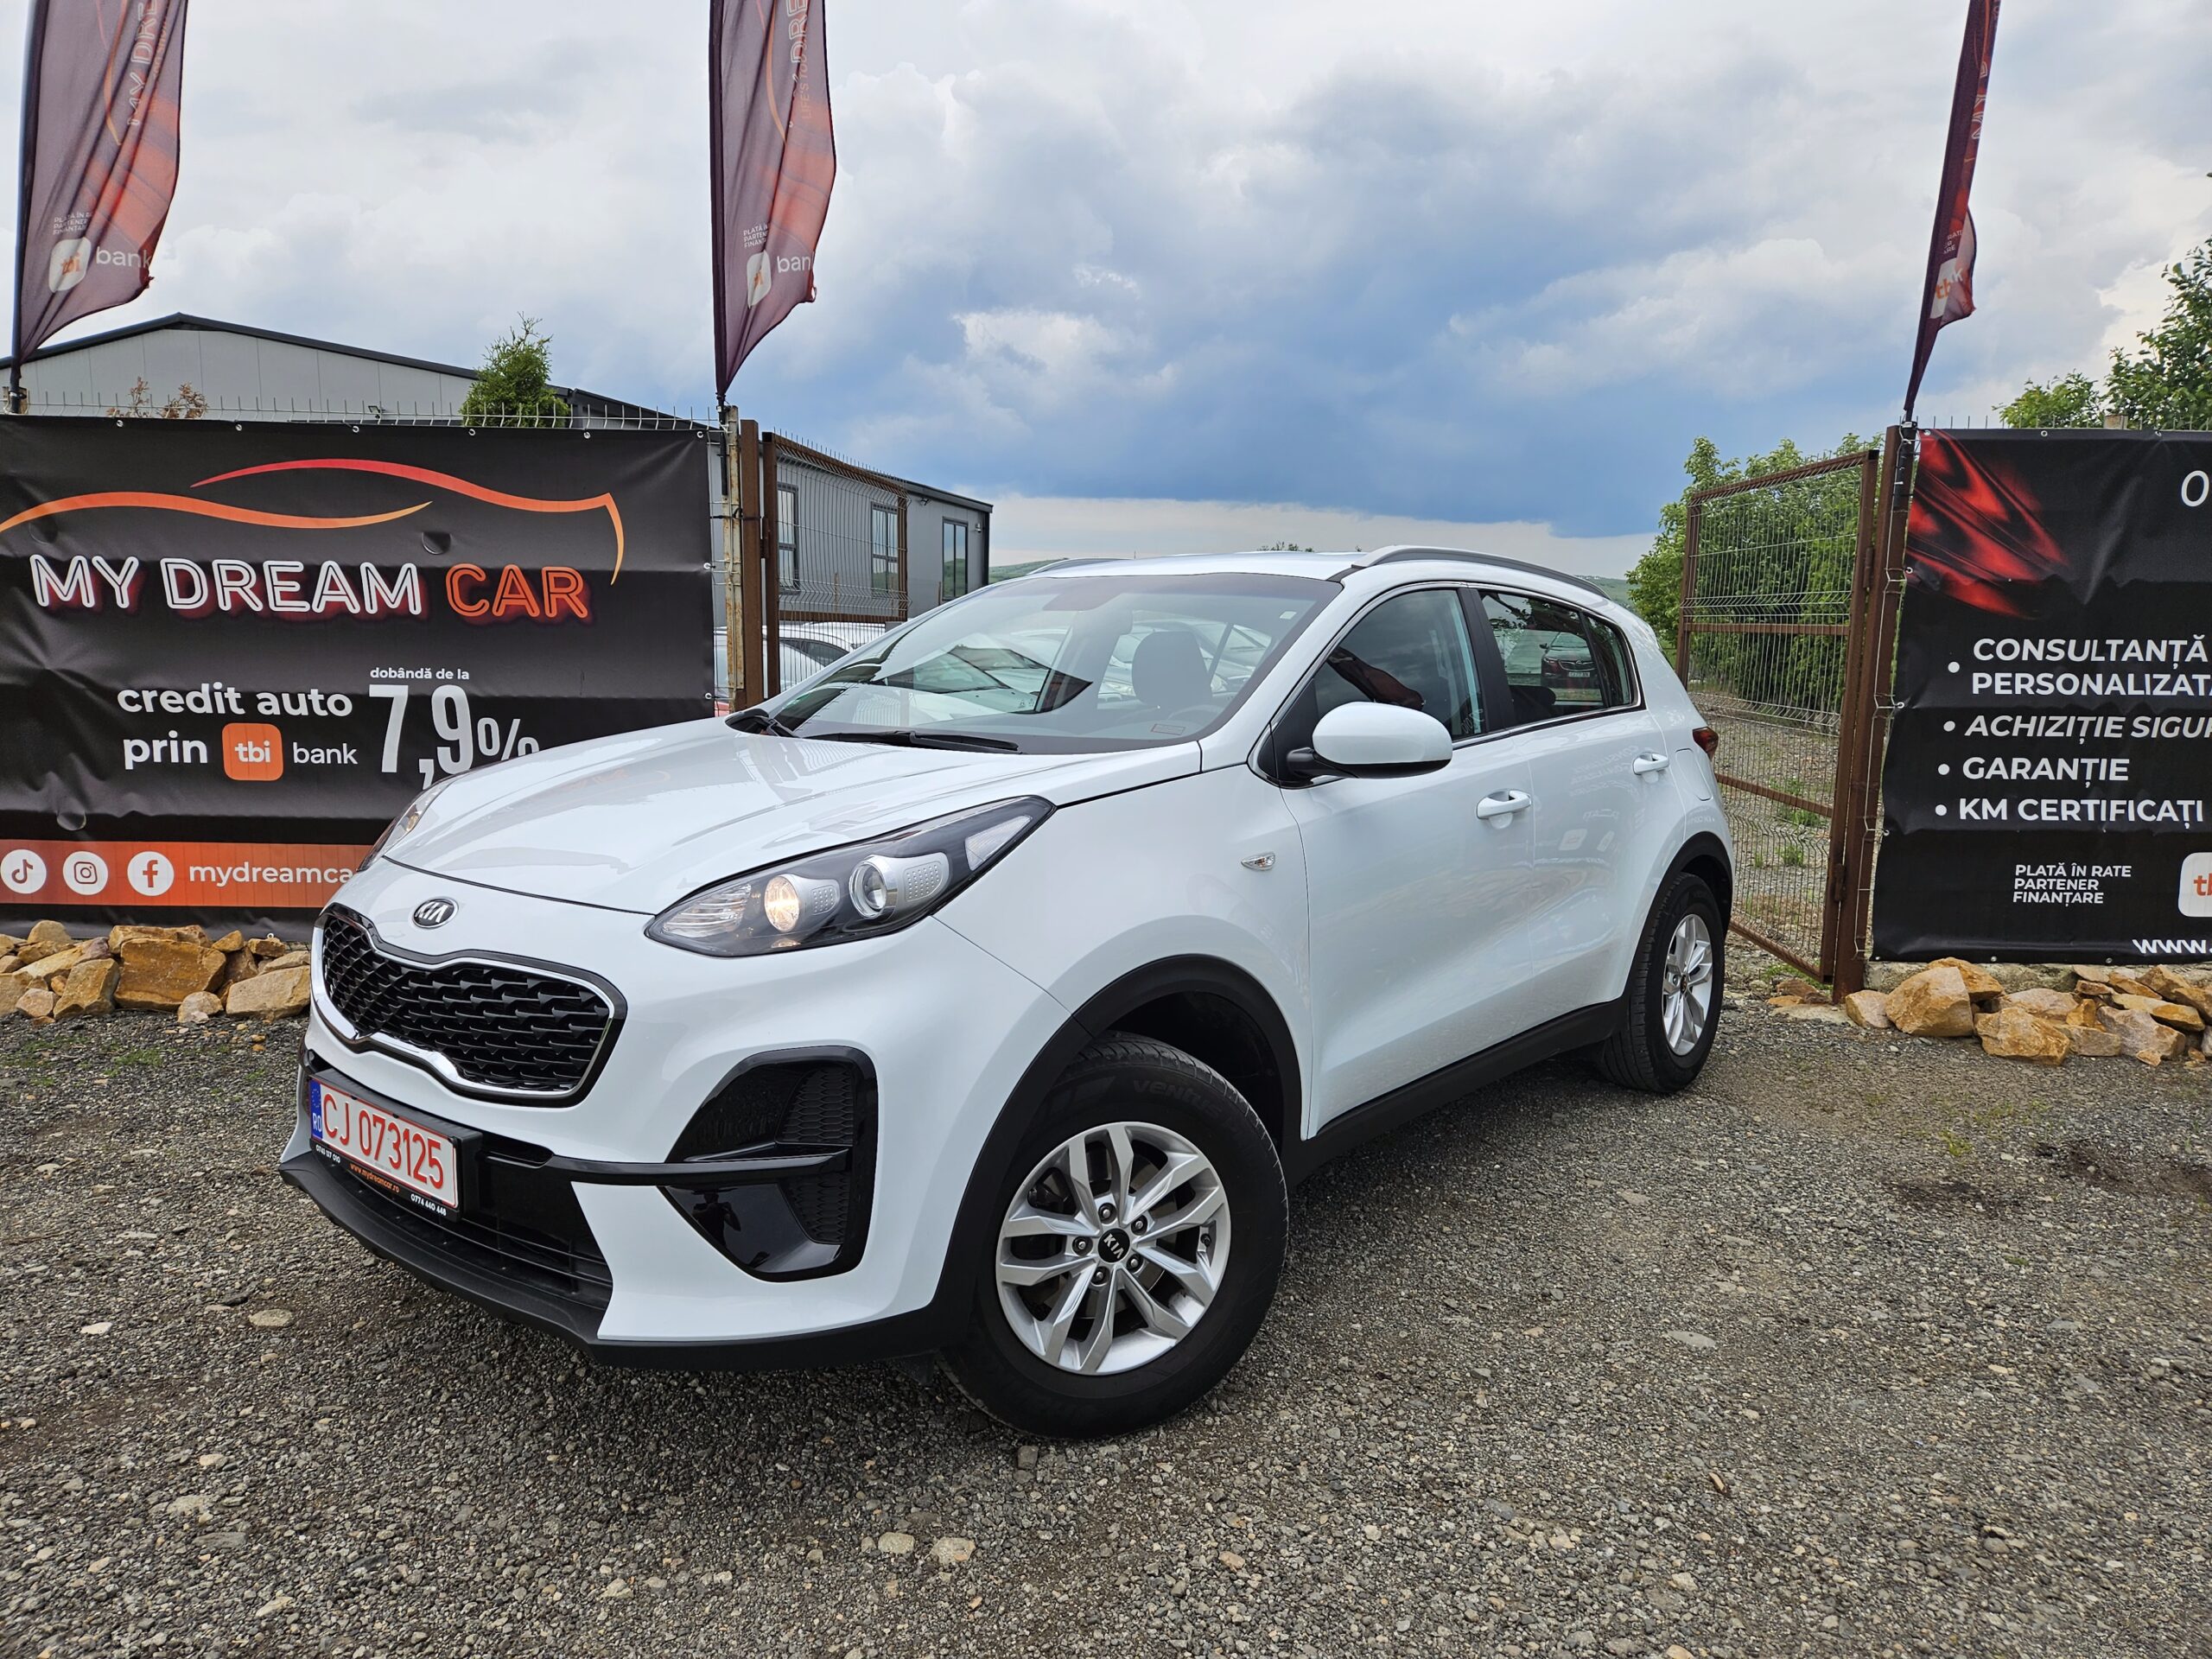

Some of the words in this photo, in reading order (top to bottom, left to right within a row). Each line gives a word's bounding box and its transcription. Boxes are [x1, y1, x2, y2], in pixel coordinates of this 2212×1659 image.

[96, 246, 151, 268] bank
[29, 554, 139, 608] MY
[160, 558, 422, 614] DREAM
[445, 563, 588, 619] CAR
[1974, 634, 2208, 670] CONSULTANȚĂ
[370, 667, 432, 679] dobândă
[435, 669, 454, 680] de
[457, 669, 470, 680] la
[1972, 672, 2212, 696] PERSONALIZAT
[117, 682, 246, 715] credit
[257, 688, 353, 717] auto
[1964, 715, 2126, 745] ACHIZIȚIE
[123, 730, 208, 770] prin
[234, 741, 270, 763] tbi
[293, 742, 358, 766] bank
[1962, 757, 2130, 788] GARANȚIE
[1959, 798, 2008, 820] KM
[2018, 798, 2203, 830] CERTIFICAȚI
[2015, 862, 2067, 877] PLATĂ
[2071, 862, 2087, 877] ÎN
[2091, 865, 2132, 877] RATE
[2014, 878, 2099, 891] PARTENER
[415, 901, 449, 923] KIA
[2012, 891, 2104, 907] FINANȚARE
[313, 1112, 322, 1133] RO
[323, 1094, 350, 1146] CJ
[359, 1109, 444, 1190] 073125
[1103, 1233, 1124, 1259] KIA
